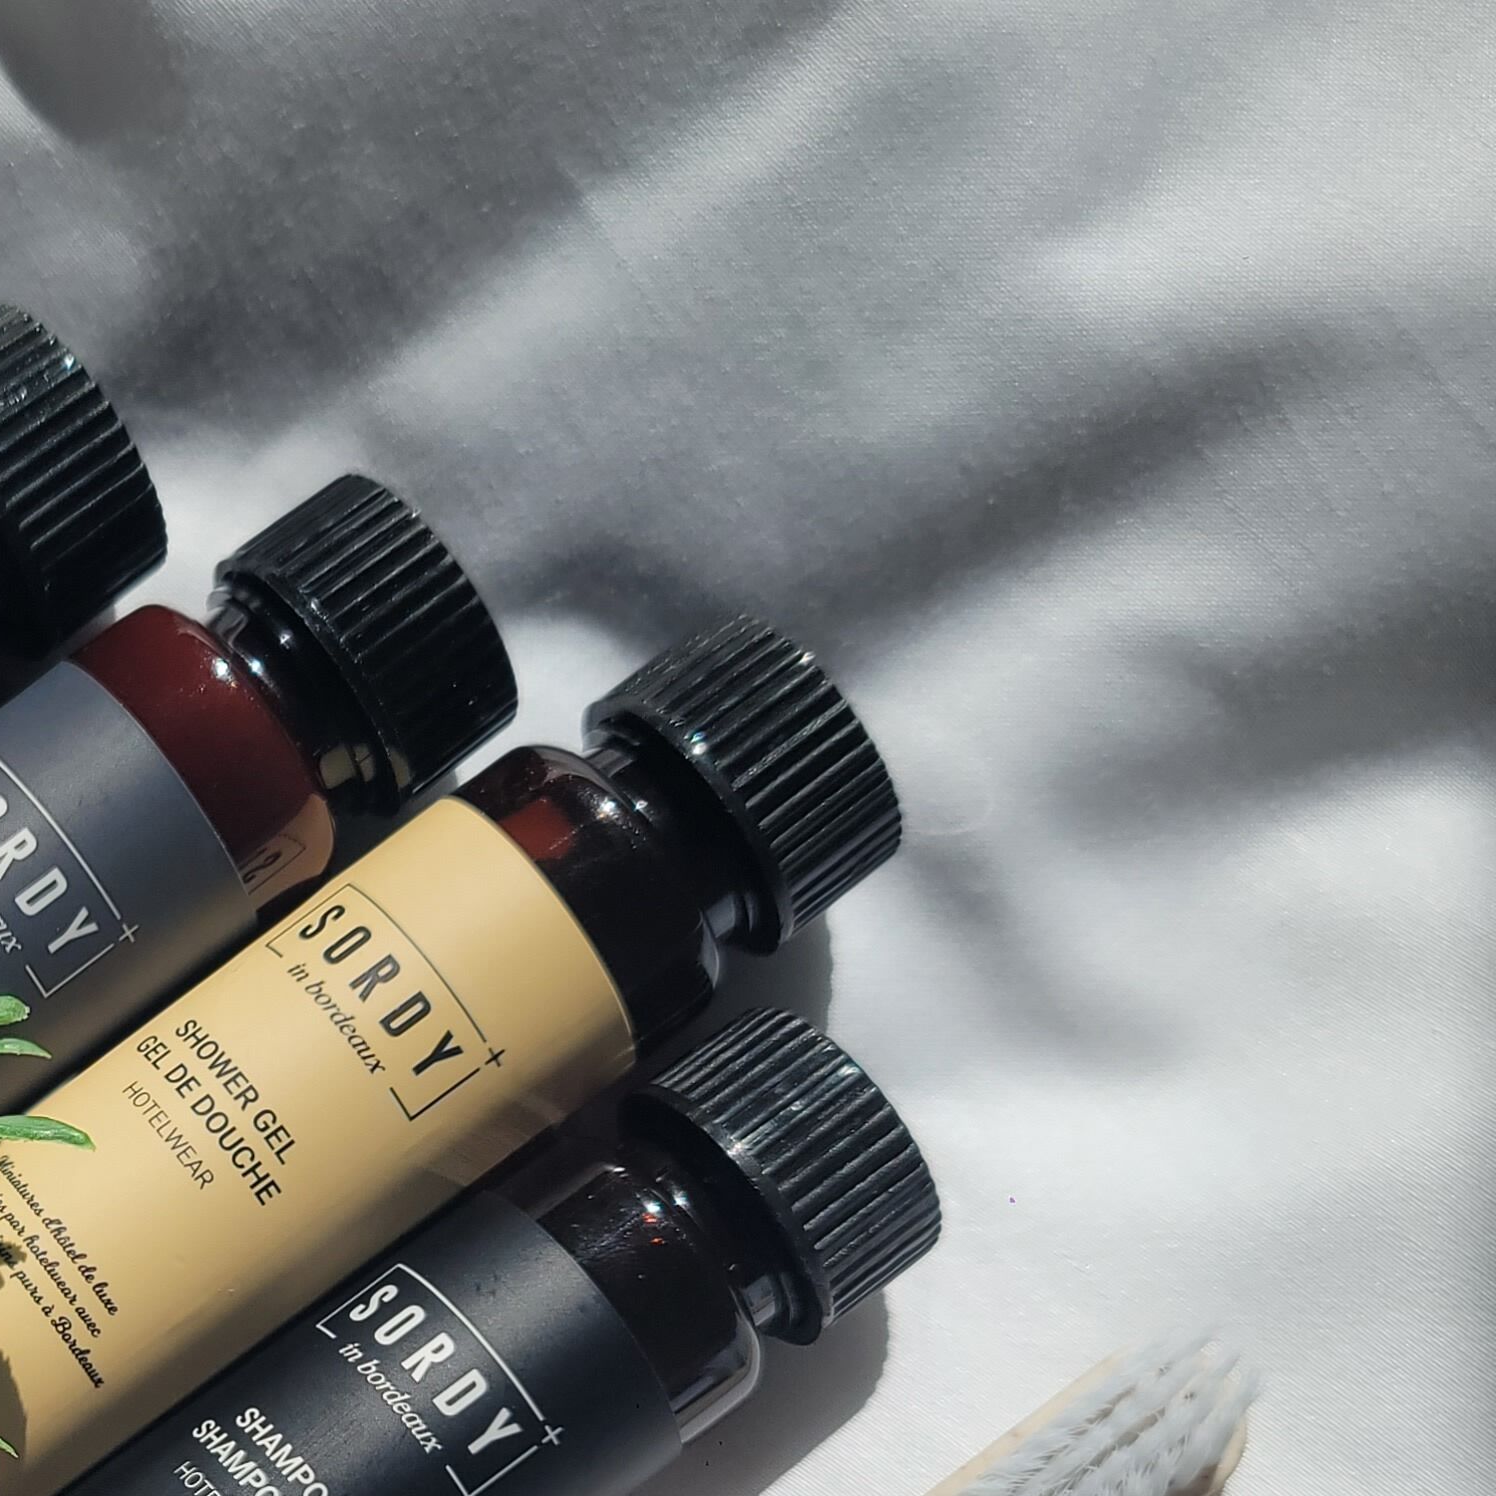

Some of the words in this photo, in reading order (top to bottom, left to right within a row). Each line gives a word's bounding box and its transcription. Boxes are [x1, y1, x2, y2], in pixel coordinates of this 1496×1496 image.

[286, 963, 309, 983] in
[304, 980, 386, 1075] bordeaux
[298, 904, 464, 1076] SORDY
[122, 1081, 214, 1190] HOTELWEAR
[136, 1035, 171, 1070] GEL
[164, 1063, 202, 1099] DE
[190, 1094, 282, 1206] DOUCHE
[175, 1019, 260, 1111] SHOWER
[253, 1109, 295, 1166] GEL
[1, 1211, 26, 1237] par
[23, 1235, 77, 1306] hotelwear
[75, 1301, 101, 1338] avec
[10, 1269, 44, 1306] purs
[41, 1304, 55, 1318] à
[51, 1316, 105, 1389] Bordeaux
[78, 1262, 97, 1284] de
[92, 1282, 118, 1316] luxe
[339, 1342, 363, 1363] in
[357, 1359, 443, 1454] bordeaux
[349, 1284, 523, 1455] SORDY
